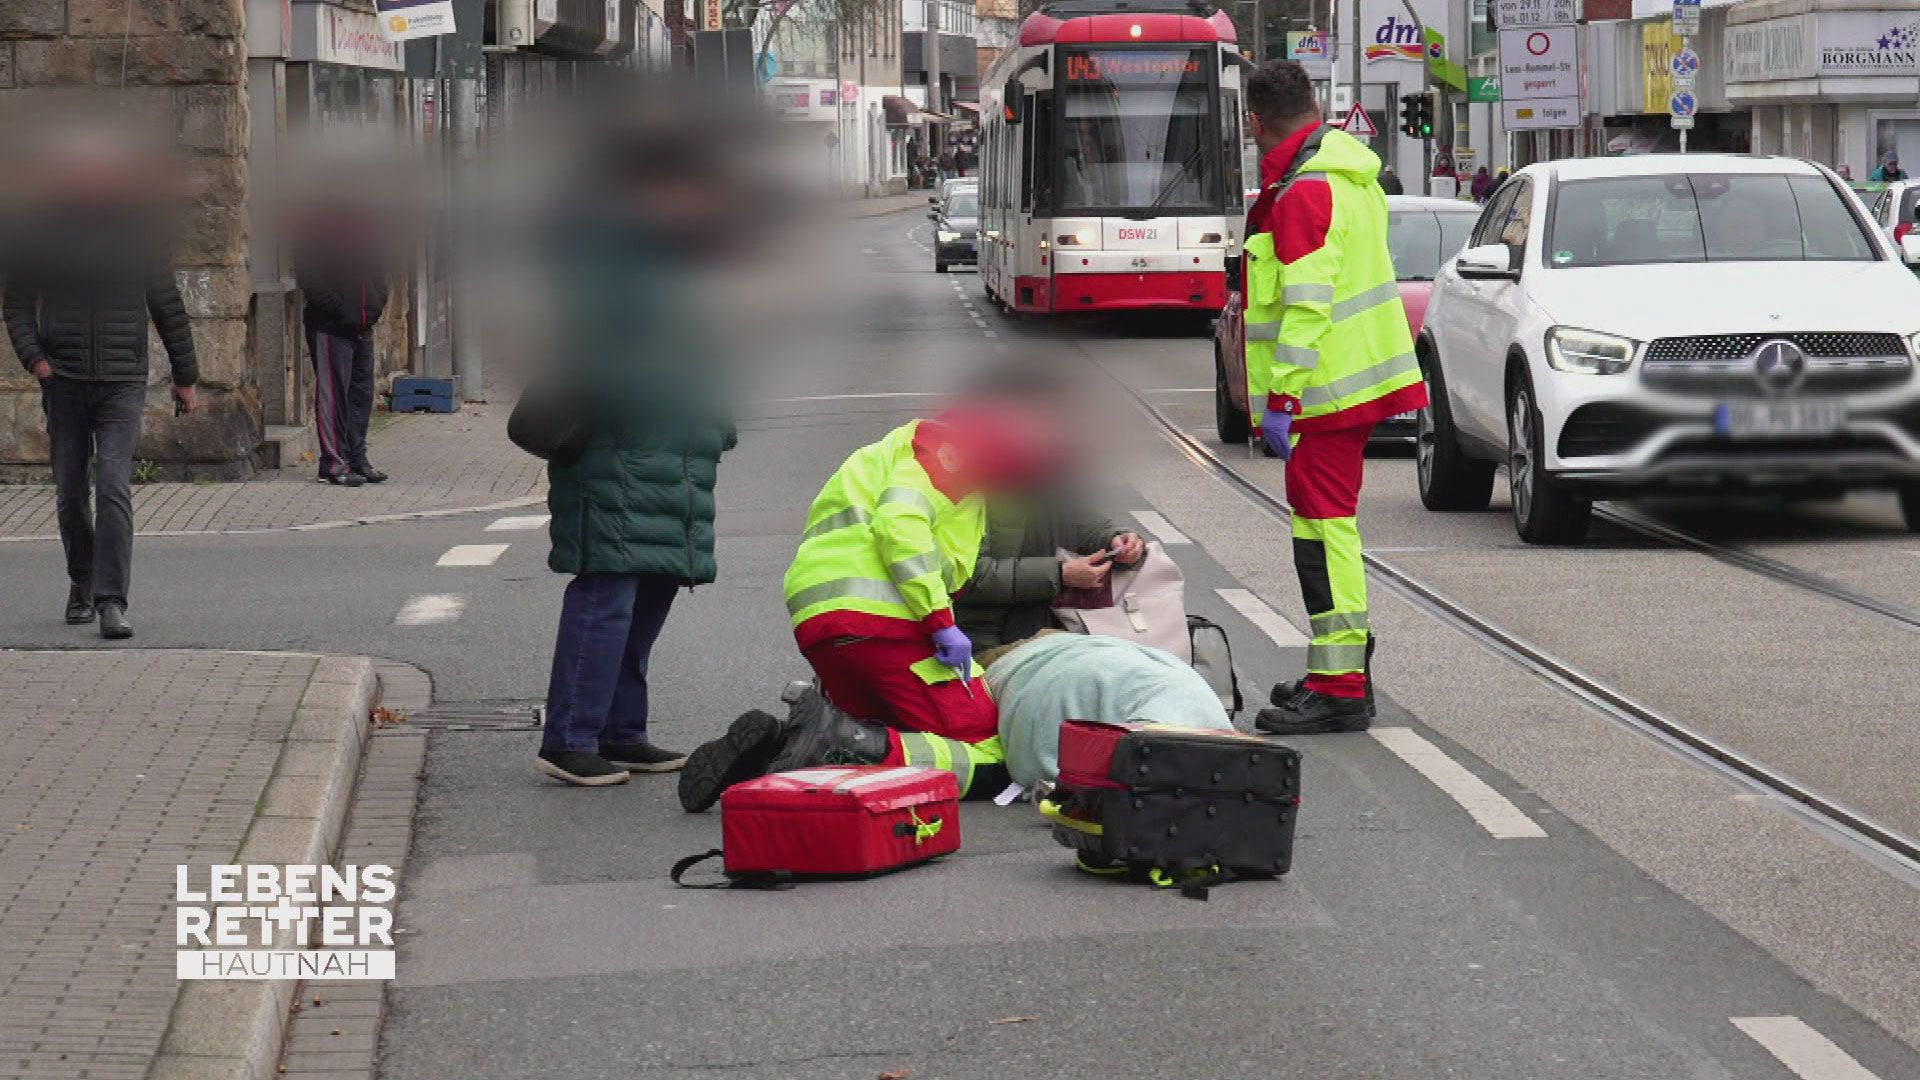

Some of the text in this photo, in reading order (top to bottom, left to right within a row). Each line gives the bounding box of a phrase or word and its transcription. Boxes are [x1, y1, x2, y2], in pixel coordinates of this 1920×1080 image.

[1501, 2, 1517, 11] von
[1502, 13, 1517, 23] bis
[1376, 16, 1420, 44] dm
[1298, 36, 1319, 48] dm
[1822, 52, 1915, 64] BORGMANN
[1066, 56, 1201, 80] U43 Westentor
[1523, 79, 1556, 91] gesperrt
[1542, 108, 1567, 120] folgen
[1119, 228, 1157, 240] DSW21
